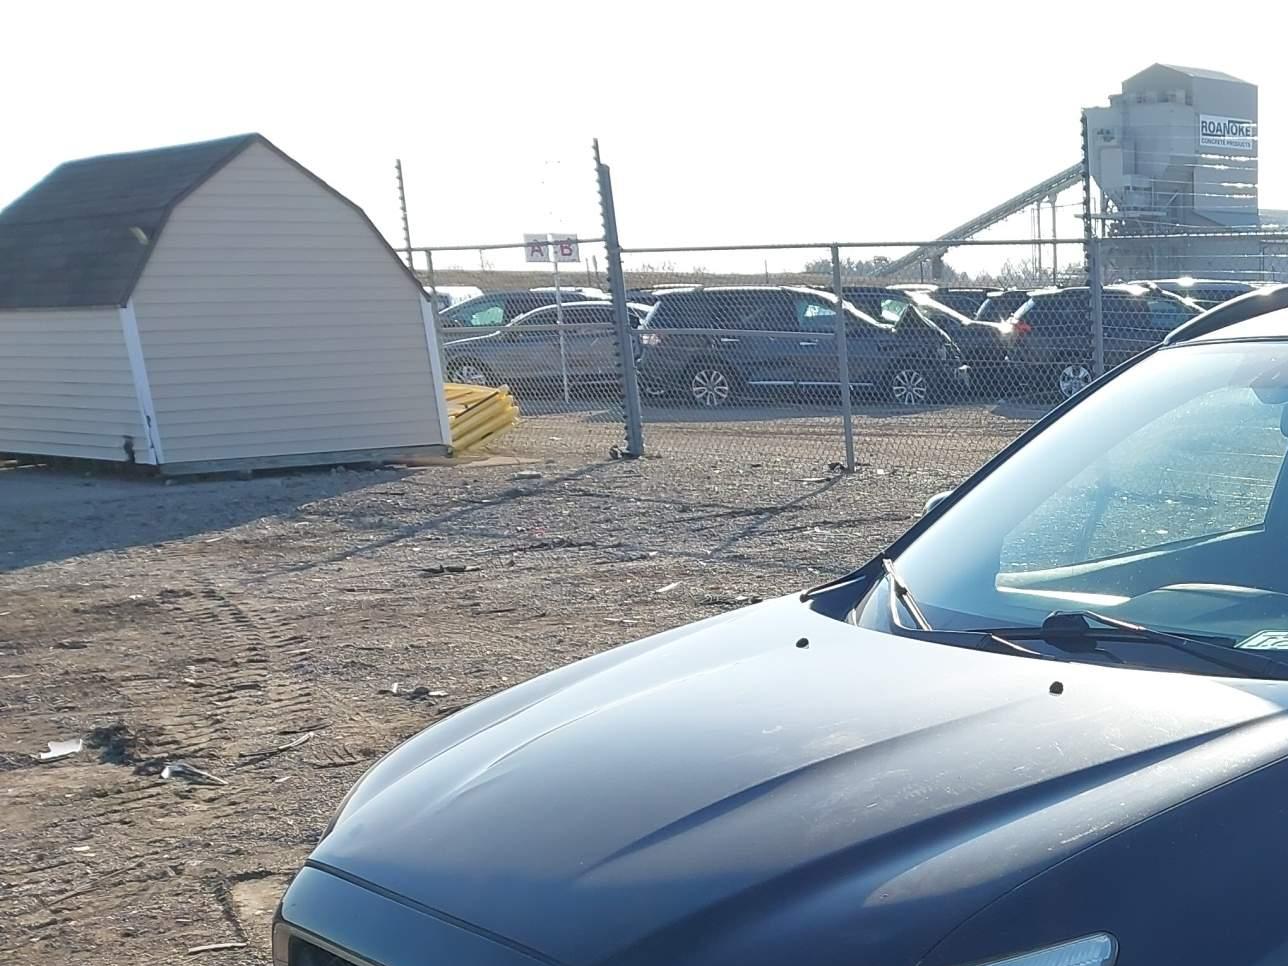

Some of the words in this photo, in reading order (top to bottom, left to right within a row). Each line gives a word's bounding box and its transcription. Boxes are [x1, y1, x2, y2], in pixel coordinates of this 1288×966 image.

[1201, 120, 1251, 137] ROANOKE
[529, 239, 545, 257] A
[559, 240, 573, 257] B
